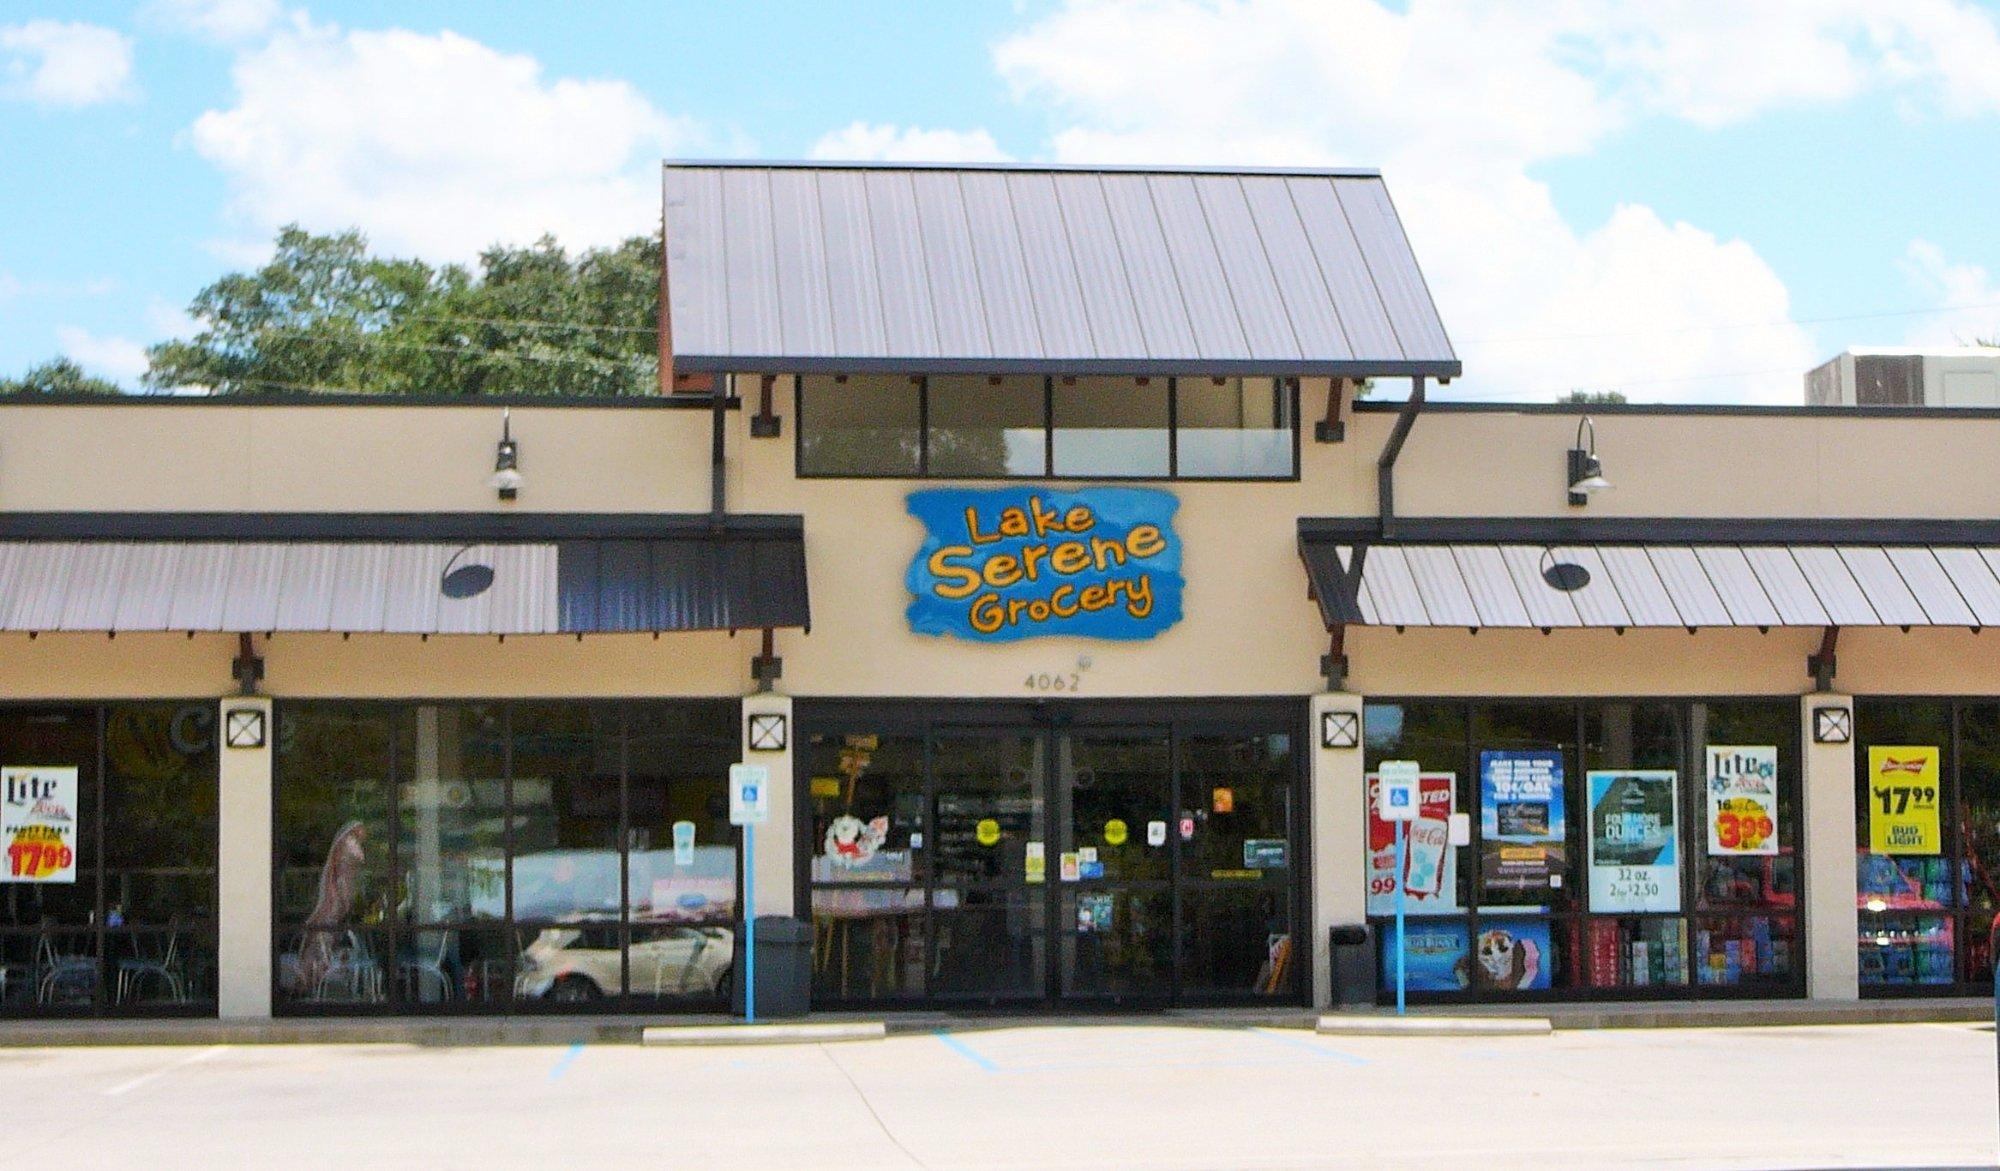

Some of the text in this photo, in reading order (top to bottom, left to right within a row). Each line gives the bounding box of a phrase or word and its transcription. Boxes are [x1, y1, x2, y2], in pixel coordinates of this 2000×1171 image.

[964, 495, 1096, 545] Lake
[927, 523, 1167, 600] Serene
[1024, 673, 1080, 691] 4062
[1713, 752, 1758, 780] Lite
[7, 774, 57, 806] Lite
[1886, 835, 1923, 846] LIGHT
[1891, 825, 1919, 835] BUD
[1618, 868, 1632, 881] 32
